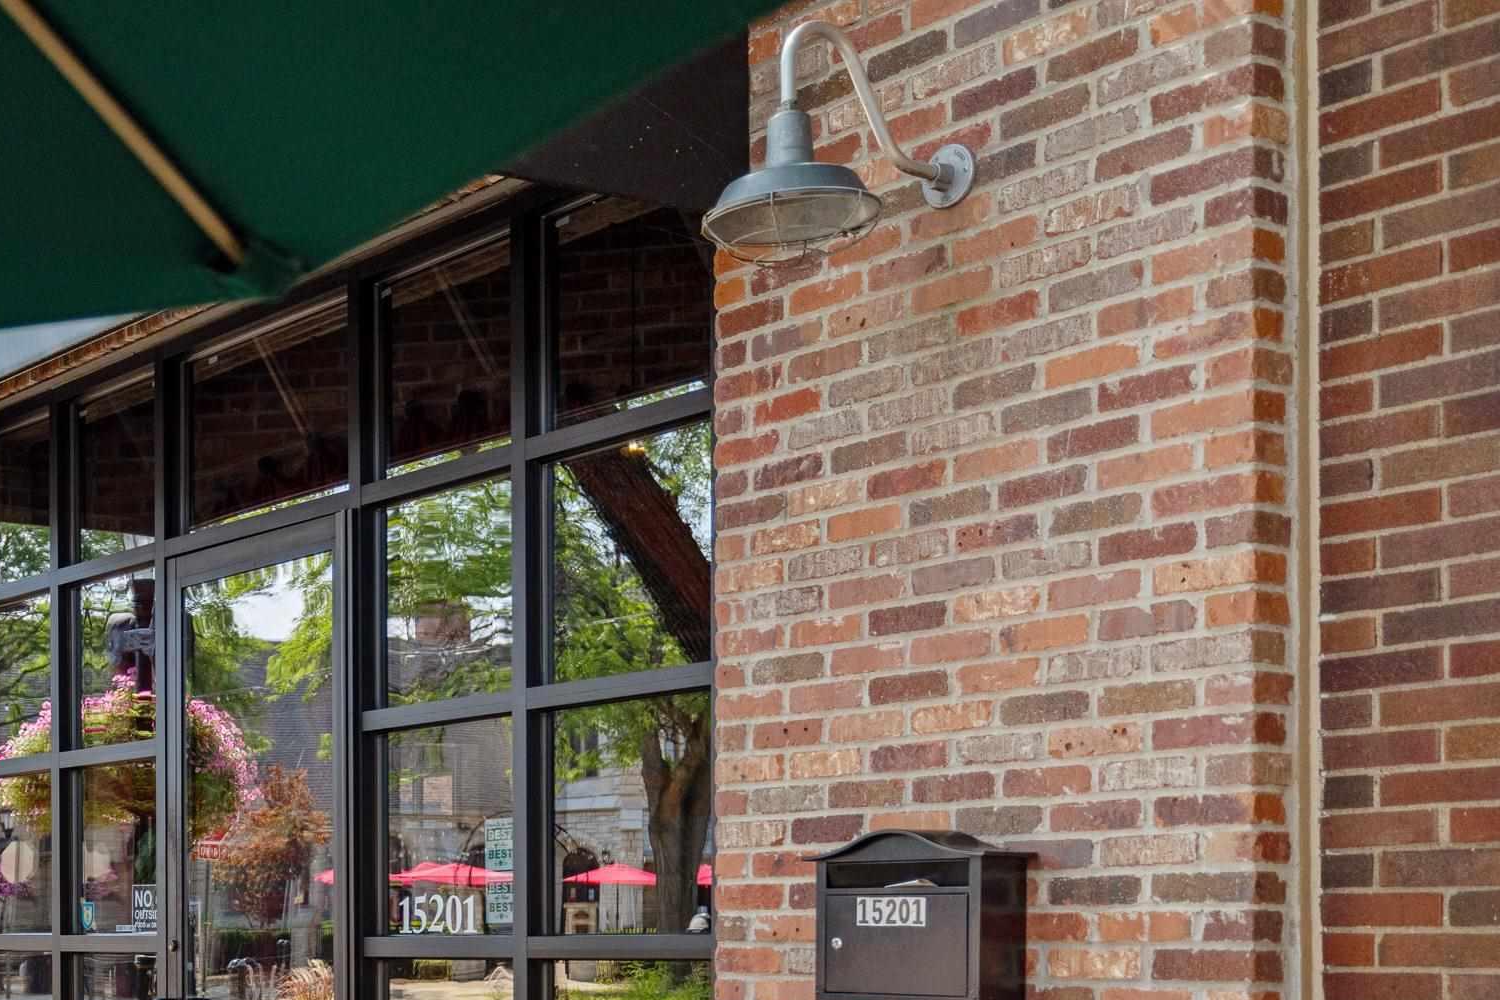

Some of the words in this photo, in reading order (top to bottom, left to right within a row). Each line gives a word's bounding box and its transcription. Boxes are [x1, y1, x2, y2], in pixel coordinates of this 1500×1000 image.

[487, 829, 512, 840] BEST
[488, 849, 512, 859] BEST
[488, 882, 513, 894] BEST
[134, 890, 152, 908] NO
[398, 892, 478, 934] 15201
[489, 902, 514, 912] BEST
[858, 899, 924, 924] 15201
